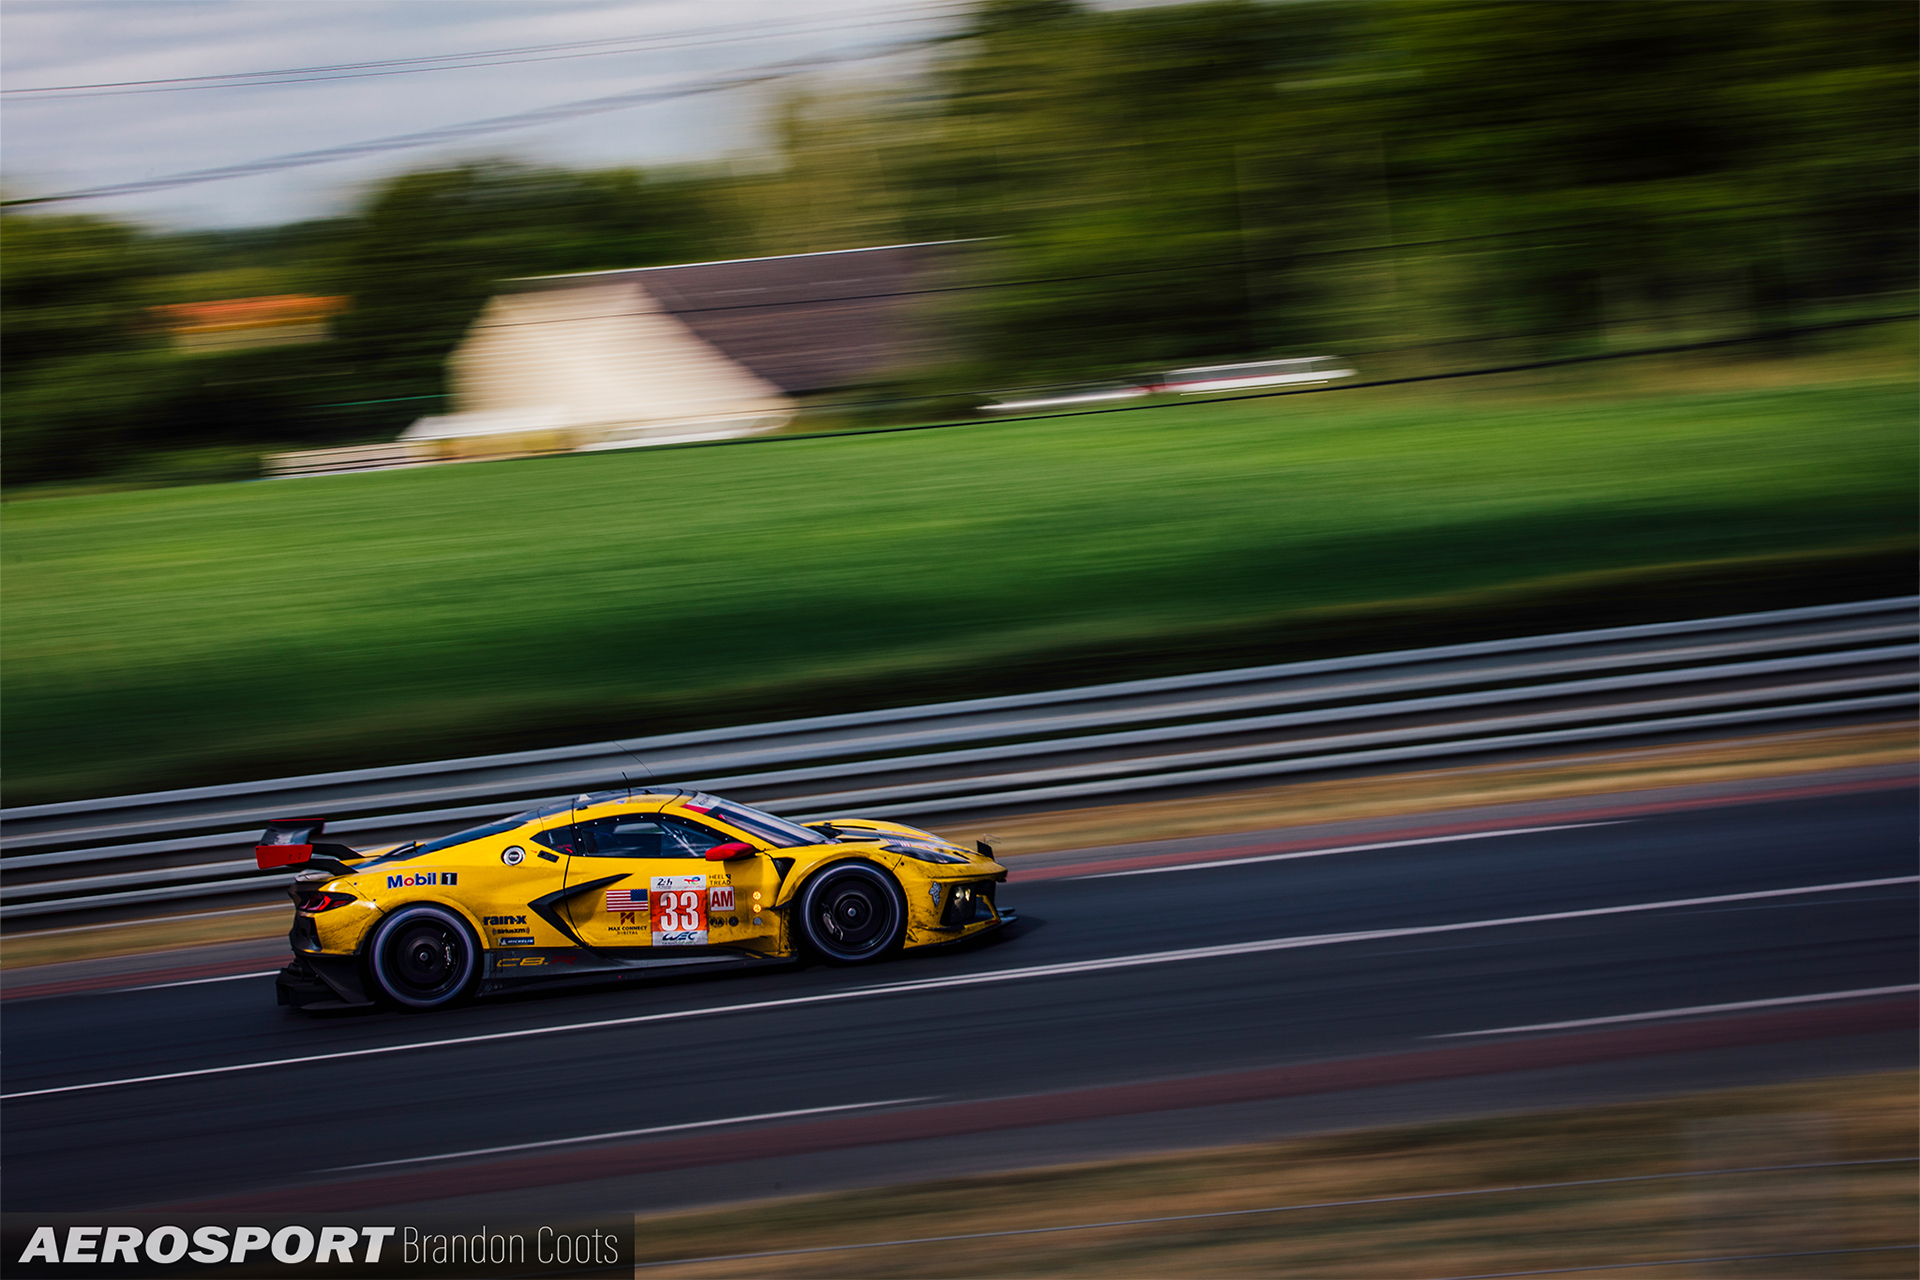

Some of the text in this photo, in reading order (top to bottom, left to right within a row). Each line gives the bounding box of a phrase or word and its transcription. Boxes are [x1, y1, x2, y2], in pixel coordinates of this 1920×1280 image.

[387, 872, 437, 889] Mobil
[711, 890, 733, 908] AM
[660, 891, 699, 932] 33
[661, 931, 698, 941] WEC
